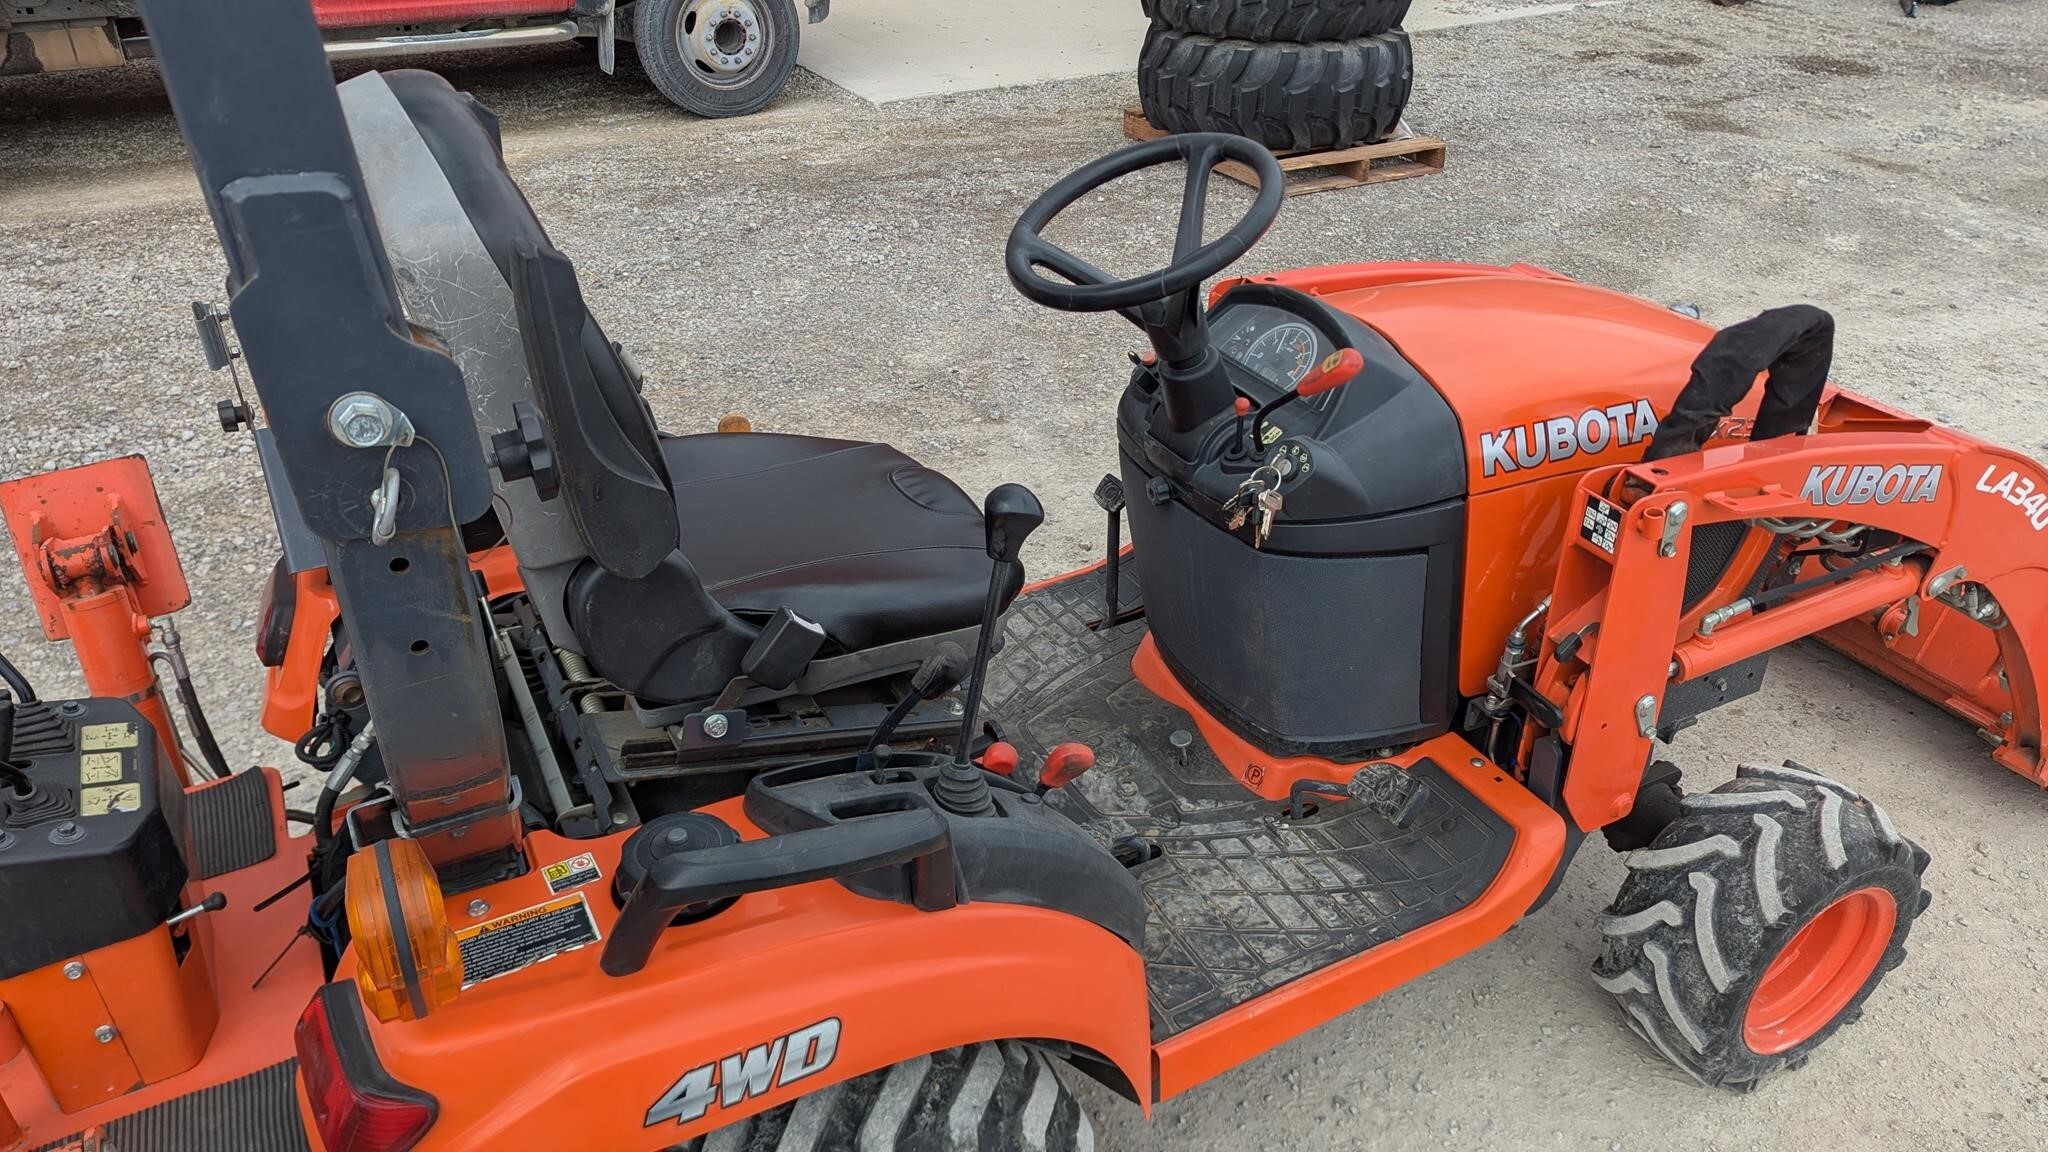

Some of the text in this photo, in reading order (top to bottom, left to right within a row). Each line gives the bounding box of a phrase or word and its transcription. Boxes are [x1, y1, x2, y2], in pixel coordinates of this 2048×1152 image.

[1480, 399, 1659, 478] KUBOTA
[1800, 464, 1944, 506] KUBOTA
[477, 924, 515, 940] PERSONAL
[491, 907, 547, 928] WARNING
[643, 1017, 842, 1128] 4WD
